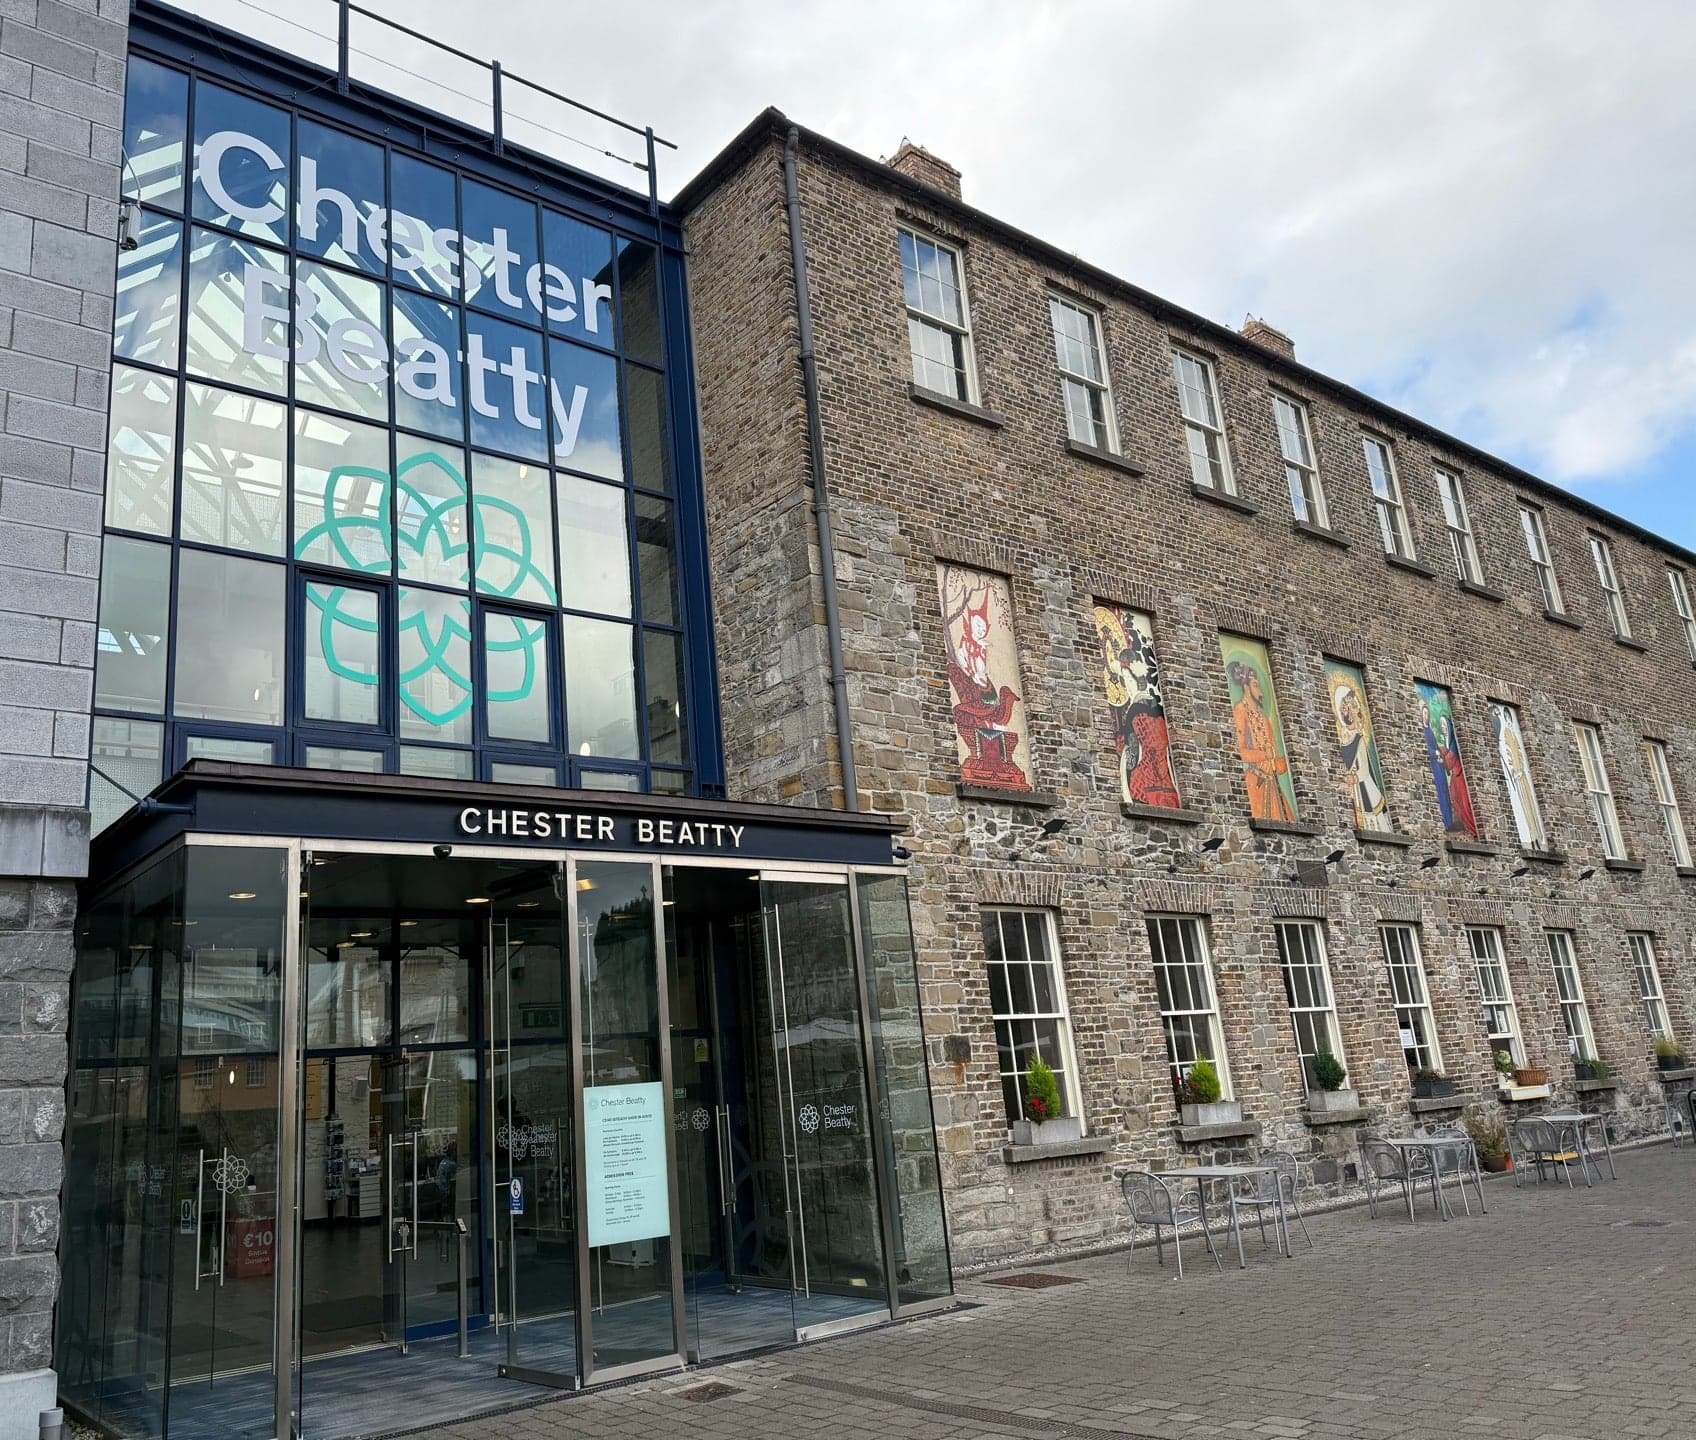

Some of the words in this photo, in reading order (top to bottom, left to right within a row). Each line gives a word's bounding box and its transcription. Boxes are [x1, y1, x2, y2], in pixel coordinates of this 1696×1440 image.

[199, 131, 611, 334] Chester
[243, 264, 588, 457] Beatty
[460, 807, 615, 841] CHESTER
[638, 819, 745, 848] BEATTY
[600, 1098, 624, 1107] Chester
[626, 1096, 647, 1105] Beatty
[823, 1103, 855, 1116] Chester
[824, 1116, 852, 1129] Beatty
[530, 1144, 554, 1159] Beatty
[243, 1231, 273, 1248] €10
